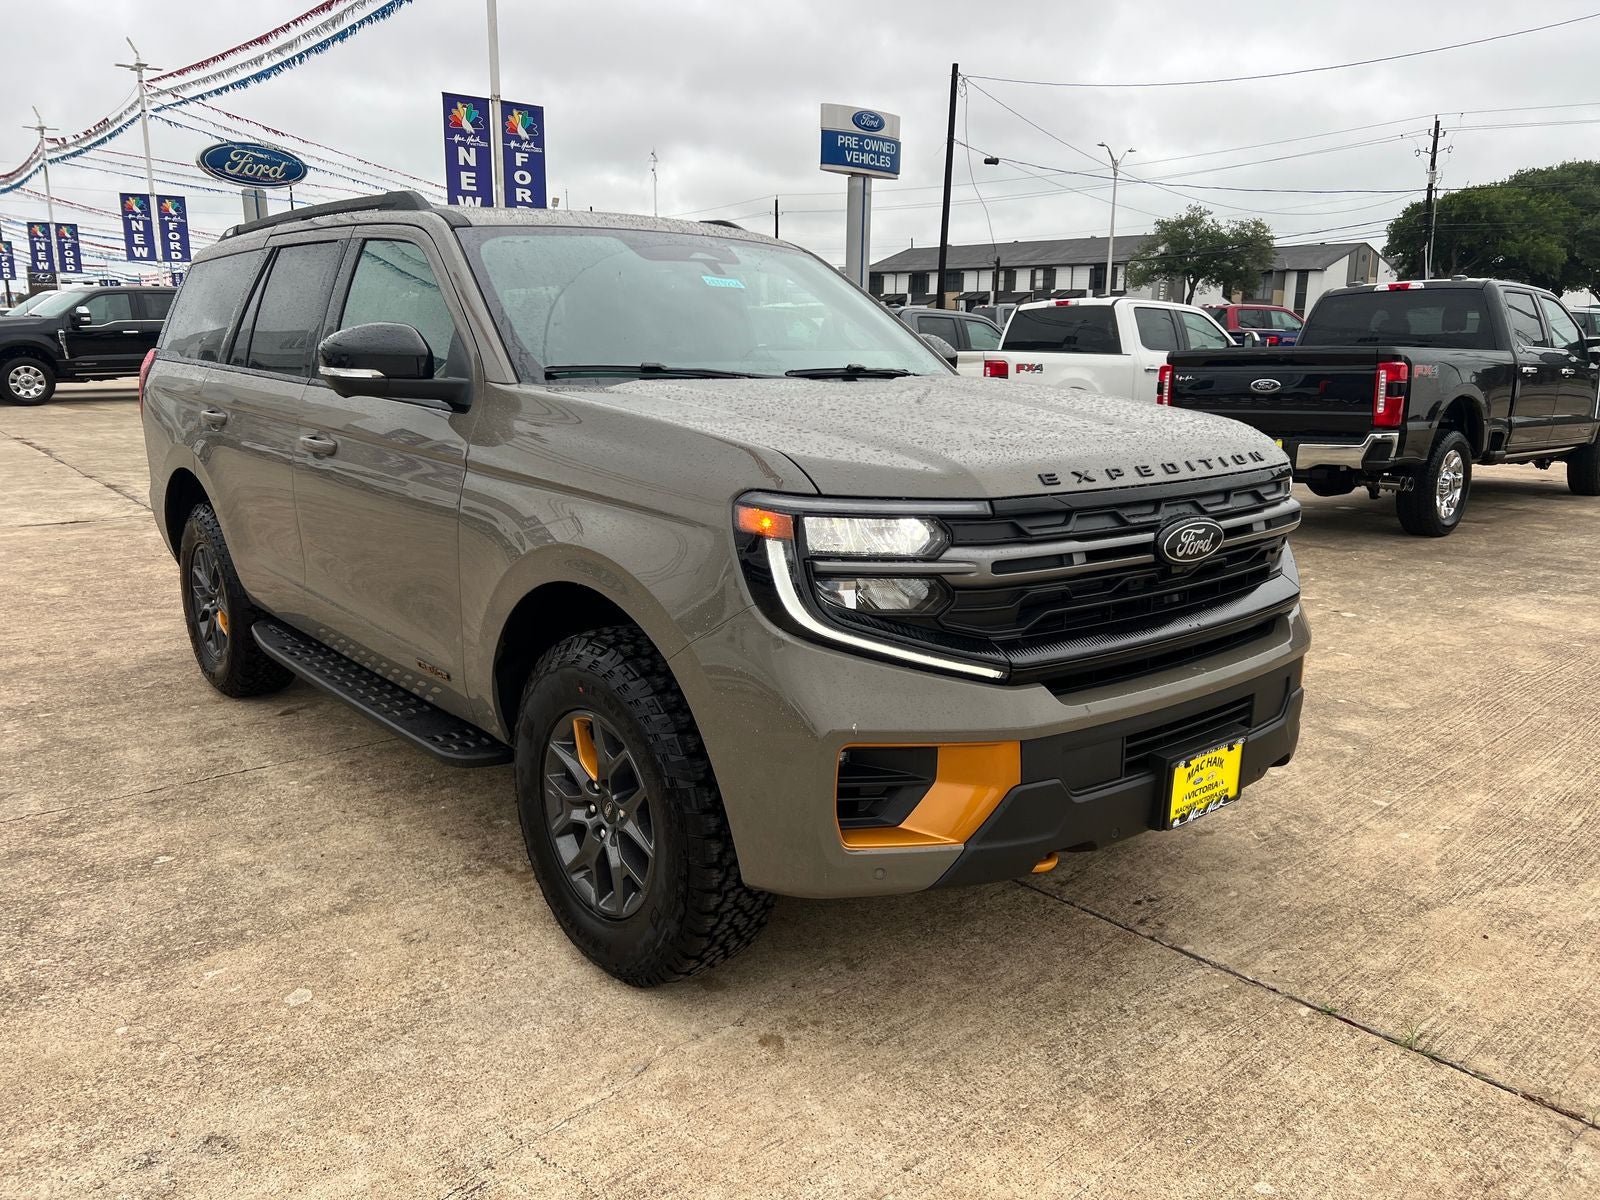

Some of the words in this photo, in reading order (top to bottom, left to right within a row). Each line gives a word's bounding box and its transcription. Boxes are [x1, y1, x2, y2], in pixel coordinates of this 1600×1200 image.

[860, 113, 880, 128] Ford
[837, 135, 896, 155] PRE-OWNED
[845, 150, 891, 168] VEHICLES
[224, 149, 286, 179] Ford
[457, 146, 482, 207] NEW
[513, 152, 533, 208] FOR
[131, 220, 149, 258] NEW
[168, 222, 182, 260] FORD
[1, 256, 11, 279] FORD
[35, 242, 49, 270] NEW
[64, 243, 76, 271] FORD
[1015, 363, 1043, 374] FX4
[1038, 450, 1265, 486] EXPEDITION
[1176, 528, 1213, 557] Ford
[1186, 759, 1206, 784] MAC
[1186, 782, 1219, 800] VICTORIA
